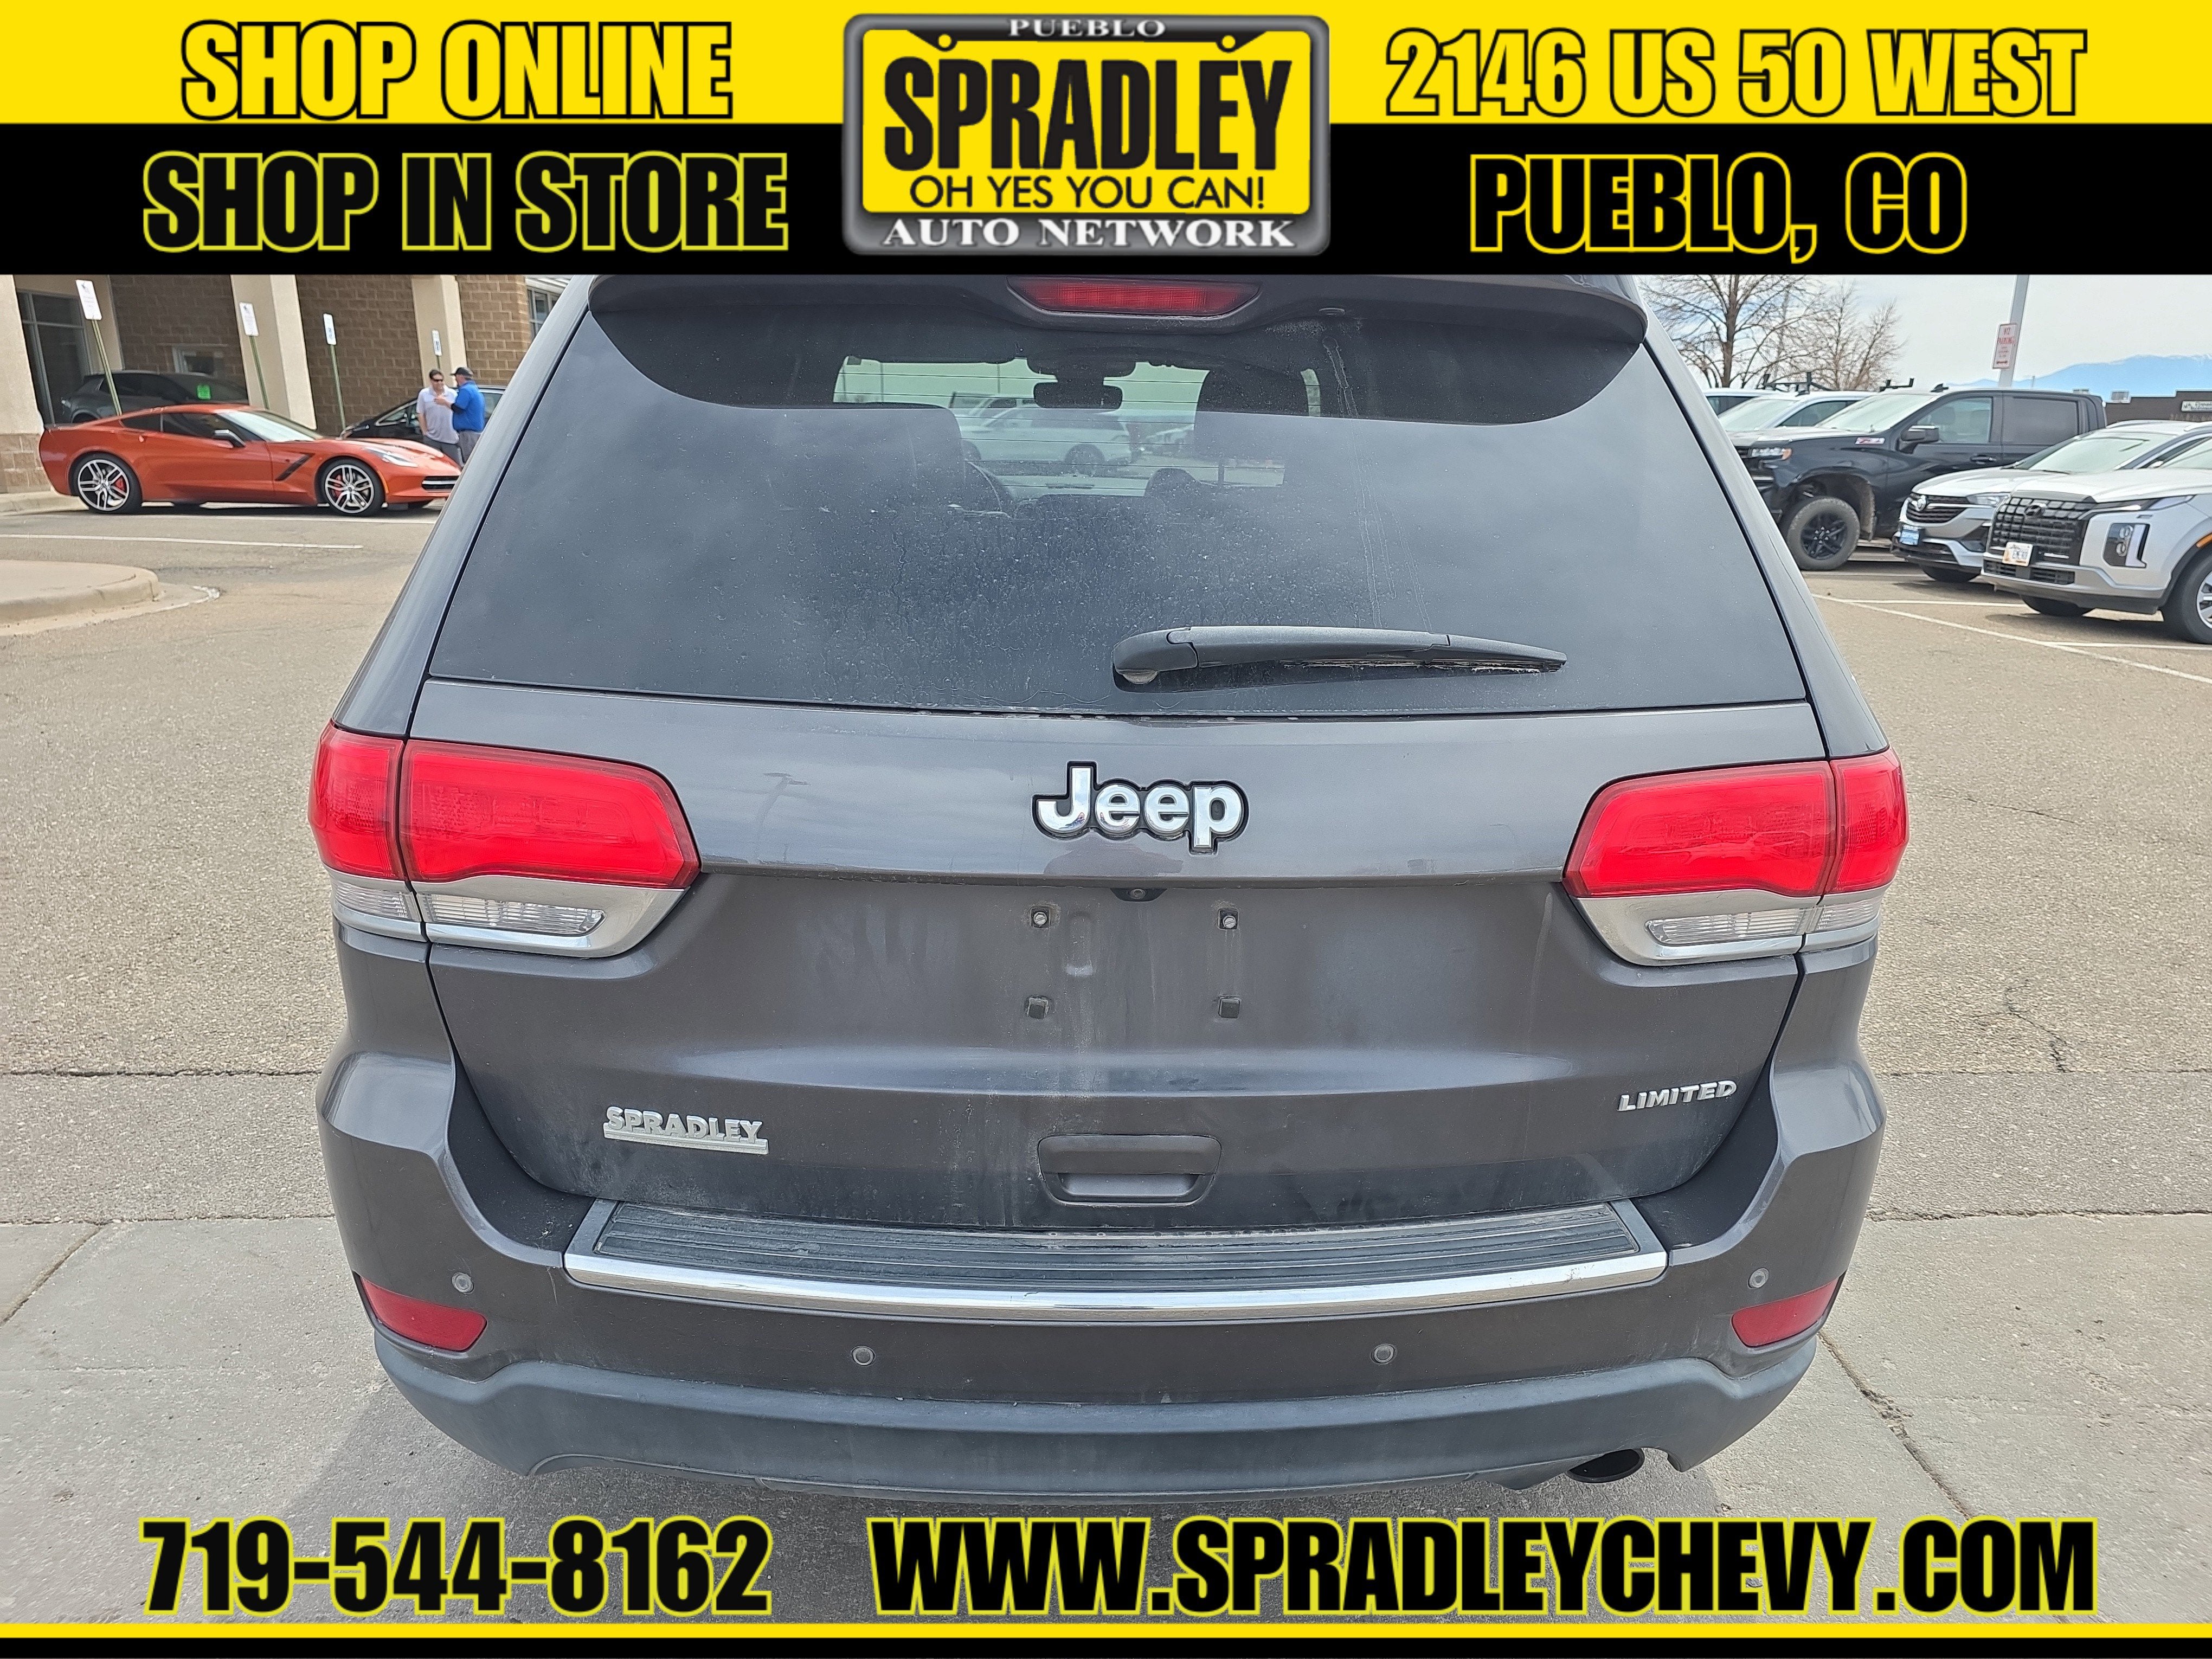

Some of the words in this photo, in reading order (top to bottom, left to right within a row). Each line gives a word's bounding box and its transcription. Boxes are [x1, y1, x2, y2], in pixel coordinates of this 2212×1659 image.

[1034, 763, 1245, 850] Jeep
[1617, 1080, 1737, 1111] LIMITED
[606, 1107, 763, 1144] SPRADLEY
